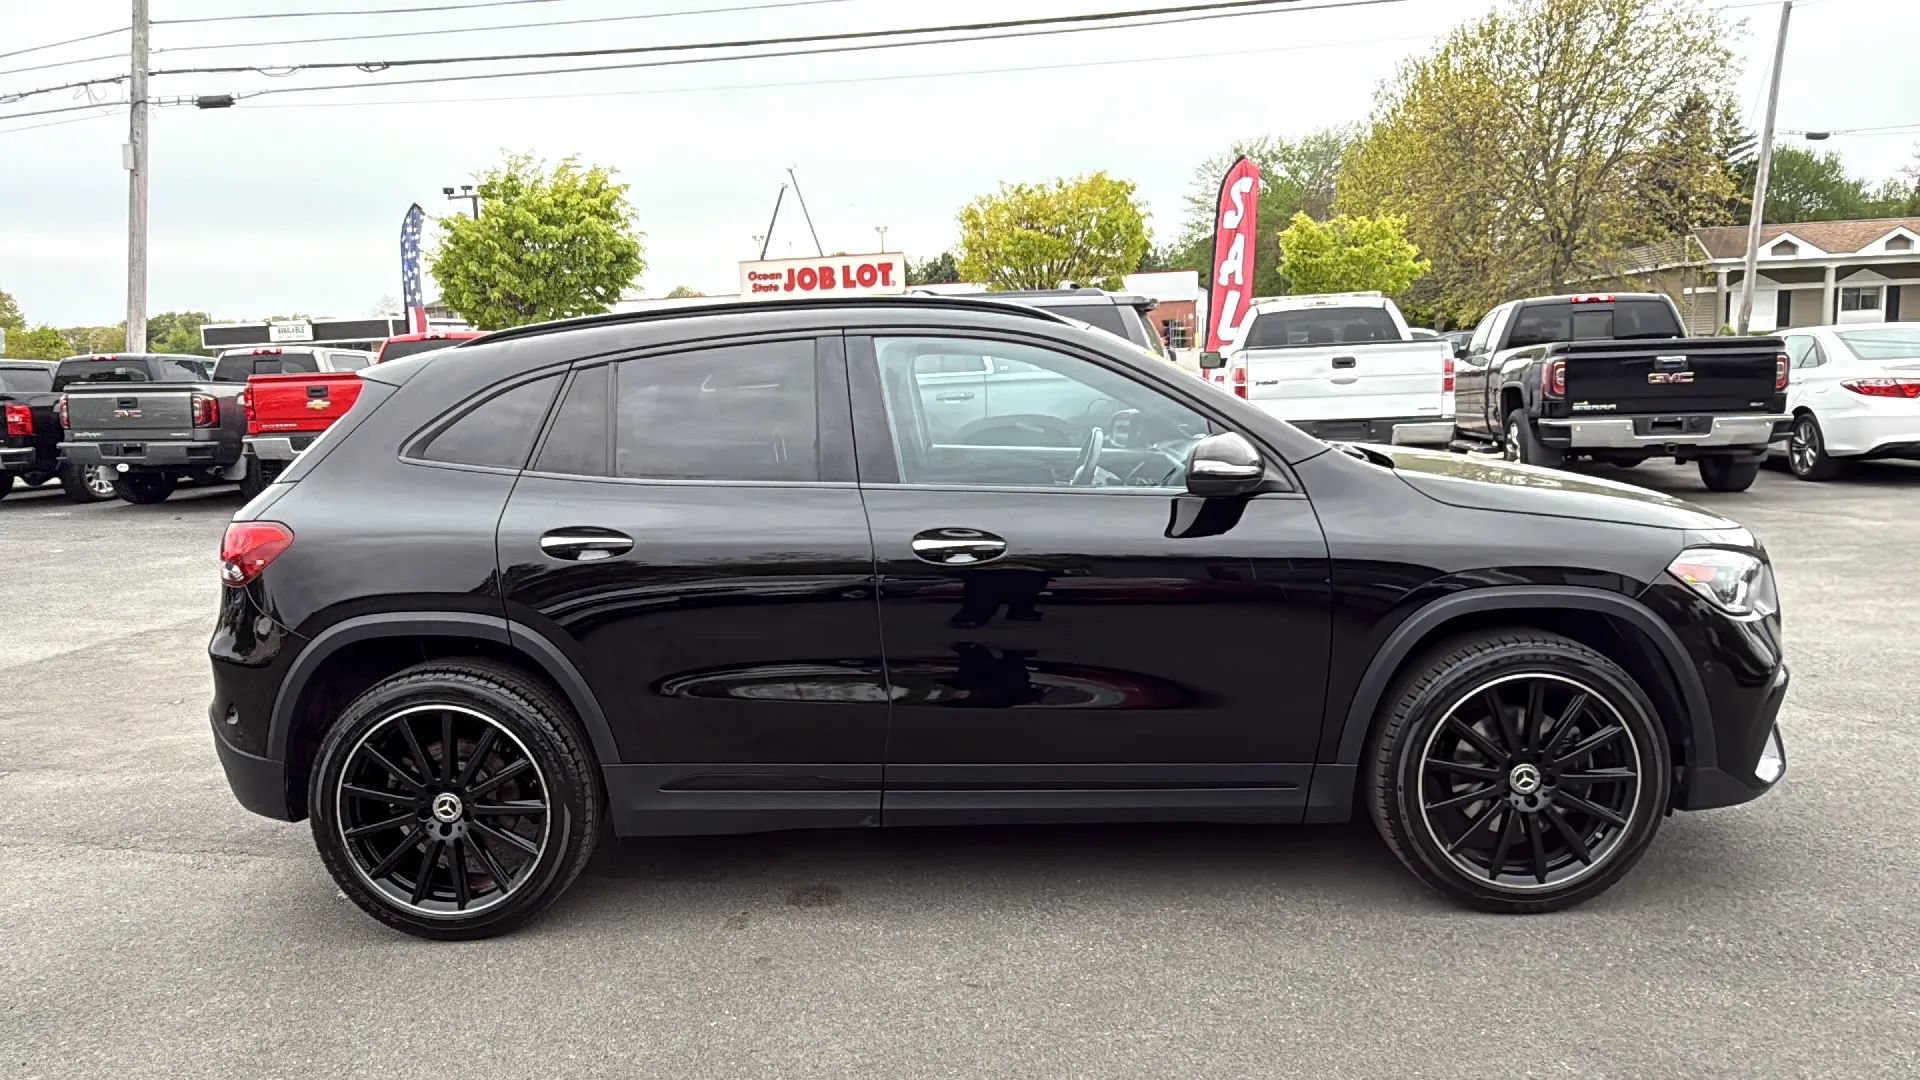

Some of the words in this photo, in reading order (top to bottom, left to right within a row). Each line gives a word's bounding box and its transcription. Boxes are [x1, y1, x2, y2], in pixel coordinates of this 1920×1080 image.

[748, 271, 782, 281] Ocean
[784, 266, 836, 292] JOB
[842, 262, 893, 288] LOT
[752, 283, 779, 293] State
[1647, 371, 1695, 384] GMC
